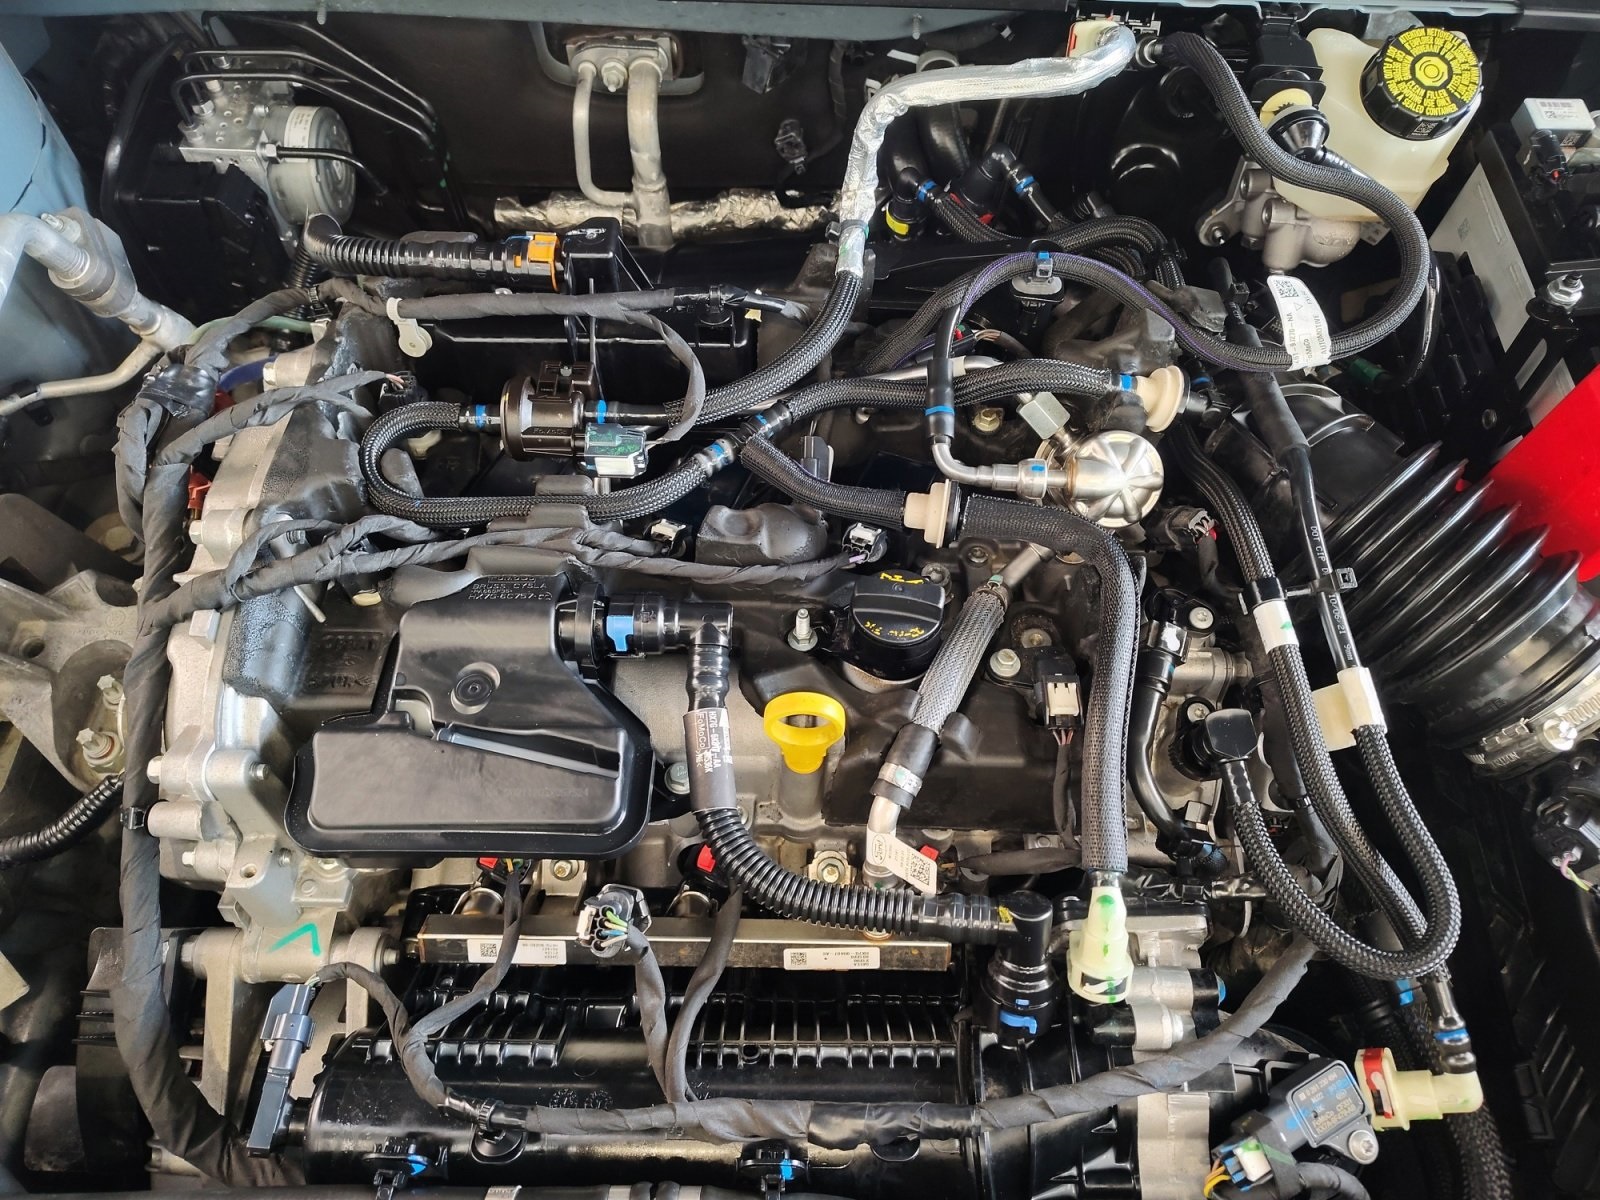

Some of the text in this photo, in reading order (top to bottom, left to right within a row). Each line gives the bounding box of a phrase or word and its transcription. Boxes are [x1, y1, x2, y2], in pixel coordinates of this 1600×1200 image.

[1386, 45, 1398, 58] DOT
[1399, 28, 1426, 44] ATTENTION
[1427, 28, 1454, 42] NETTOYER
[1452, 37, 1461, 46] LE
[1458, 43, 1477, 65] BOUCHON
[1470, 67, 1479, 84] AVANT
[1384, 63, 1393, 79] FLUID
[1392, 50, 1451, 107] CAP BEFORE REMOVING USE ONLY
[1386, 80, 1400, 96] FROM
[1407, 80, 1426, 96] CLEAN
[1426, 89, 1448, 99] FILLER
[1402, 98, 1425, 113] SEALED
[1426, 103, 1458, 116] CONTAINER
[1310, 525, 1321, 543] DOT
[1315, 545, 1326, 563] CIP
[698, 713, 706, 748] FoMoCo
